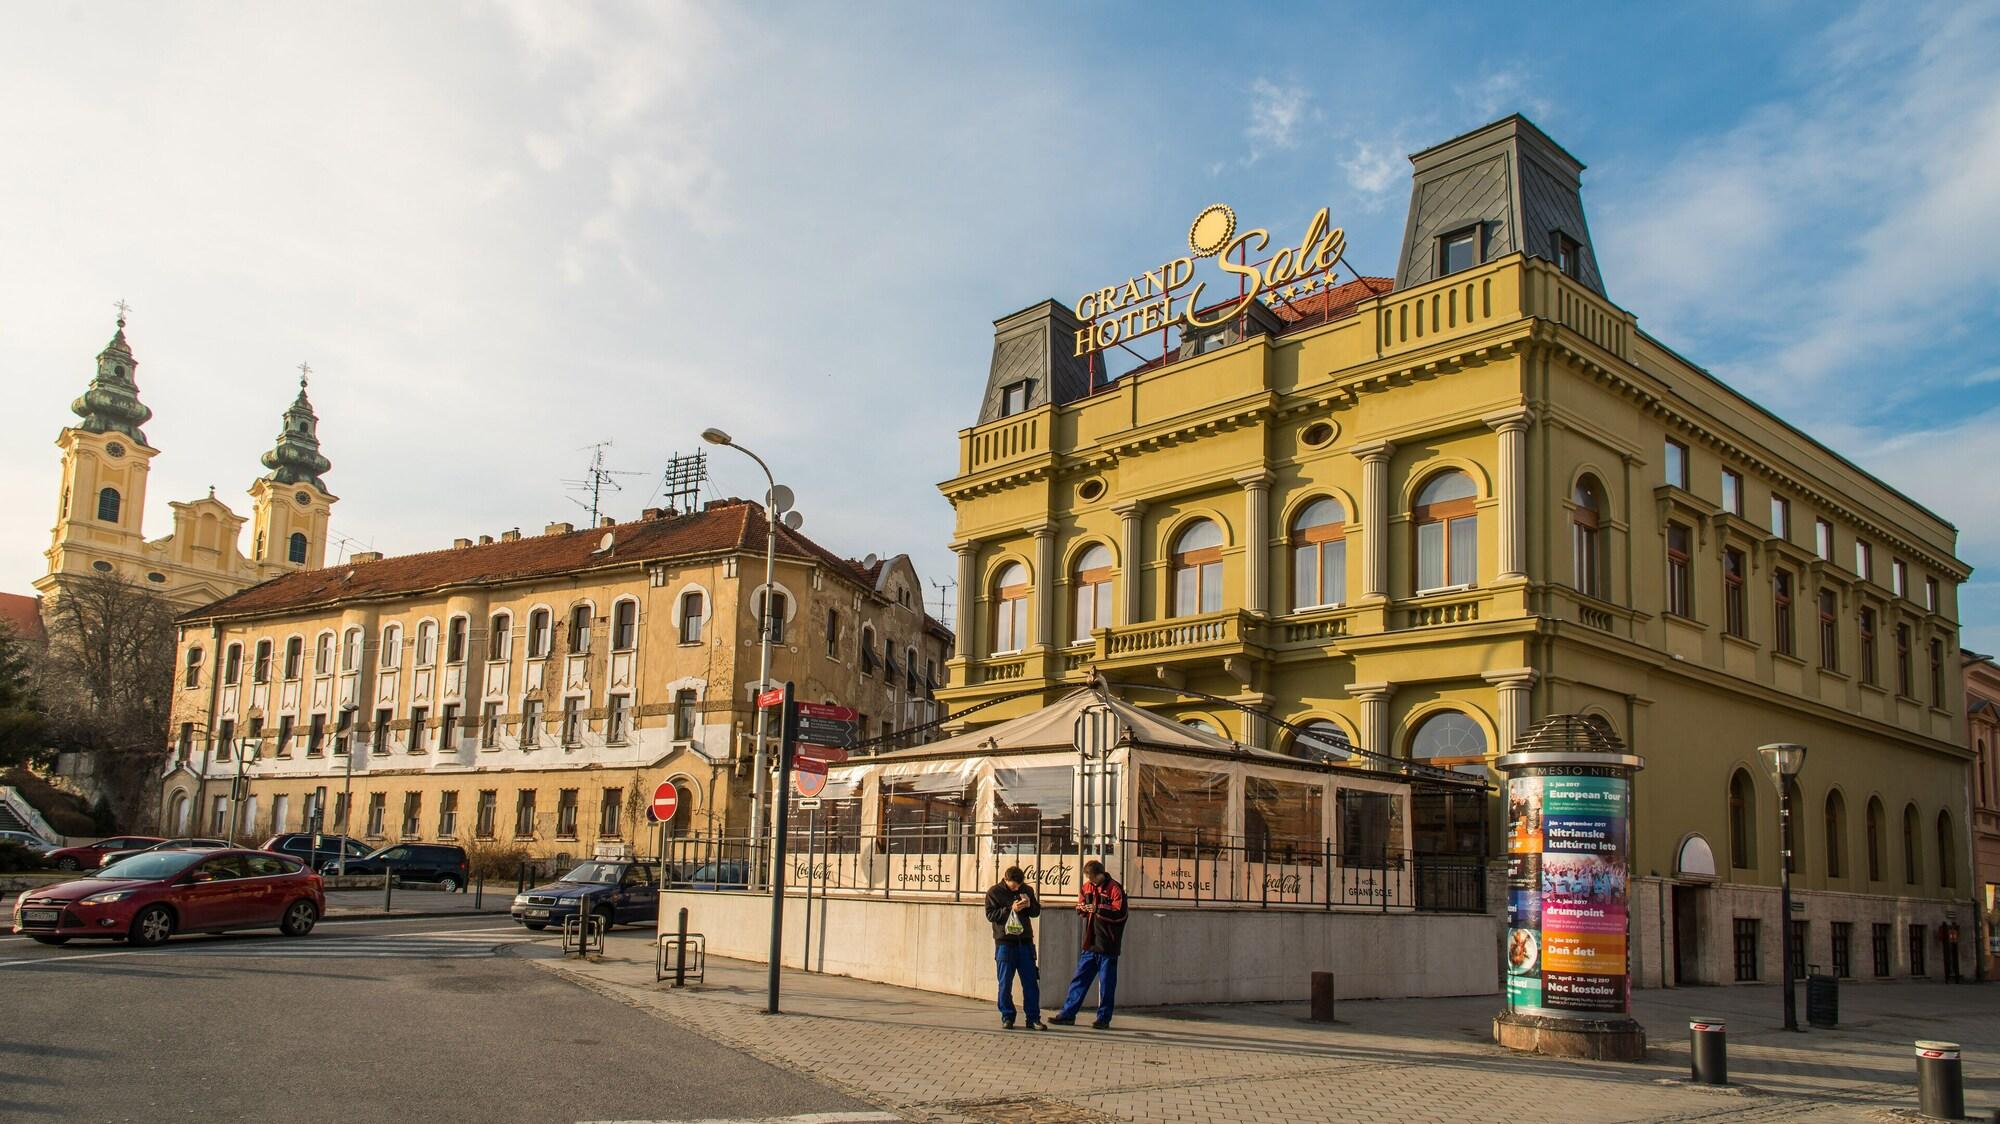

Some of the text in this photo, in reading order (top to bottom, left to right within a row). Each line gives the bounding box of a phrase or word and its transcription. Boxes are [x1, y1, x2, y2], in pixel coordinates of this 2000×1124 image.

[1186, 207, 1347, 328] Sole
[1075, 257, 1195, 321] GRAND
[1073, 297, 1184, 357] HOTEL
[1537, 767, 1622, 777] MESTO NITR
[1550, 790, 1620, 800] European Tour
[1549, 828, 1604, 838] Nitrianske
[1549, 840, 1616, 851] kultúrne leto
[796, 862, 833, 880] Coc-Coa
[1171, 870, 1192, 878] HOTEL
[898, 874, 950, 882] GRAND SOLE
[1153, 880, 1185, 890] GRAND
[1348, 887, 1392, 897] GRAND SOE
[1547, 906, 1604, 918] drumpoint
[1548, 945, 1595, 956] Deň detí
[1548, 983, 1614, 994] Noc kostolov
